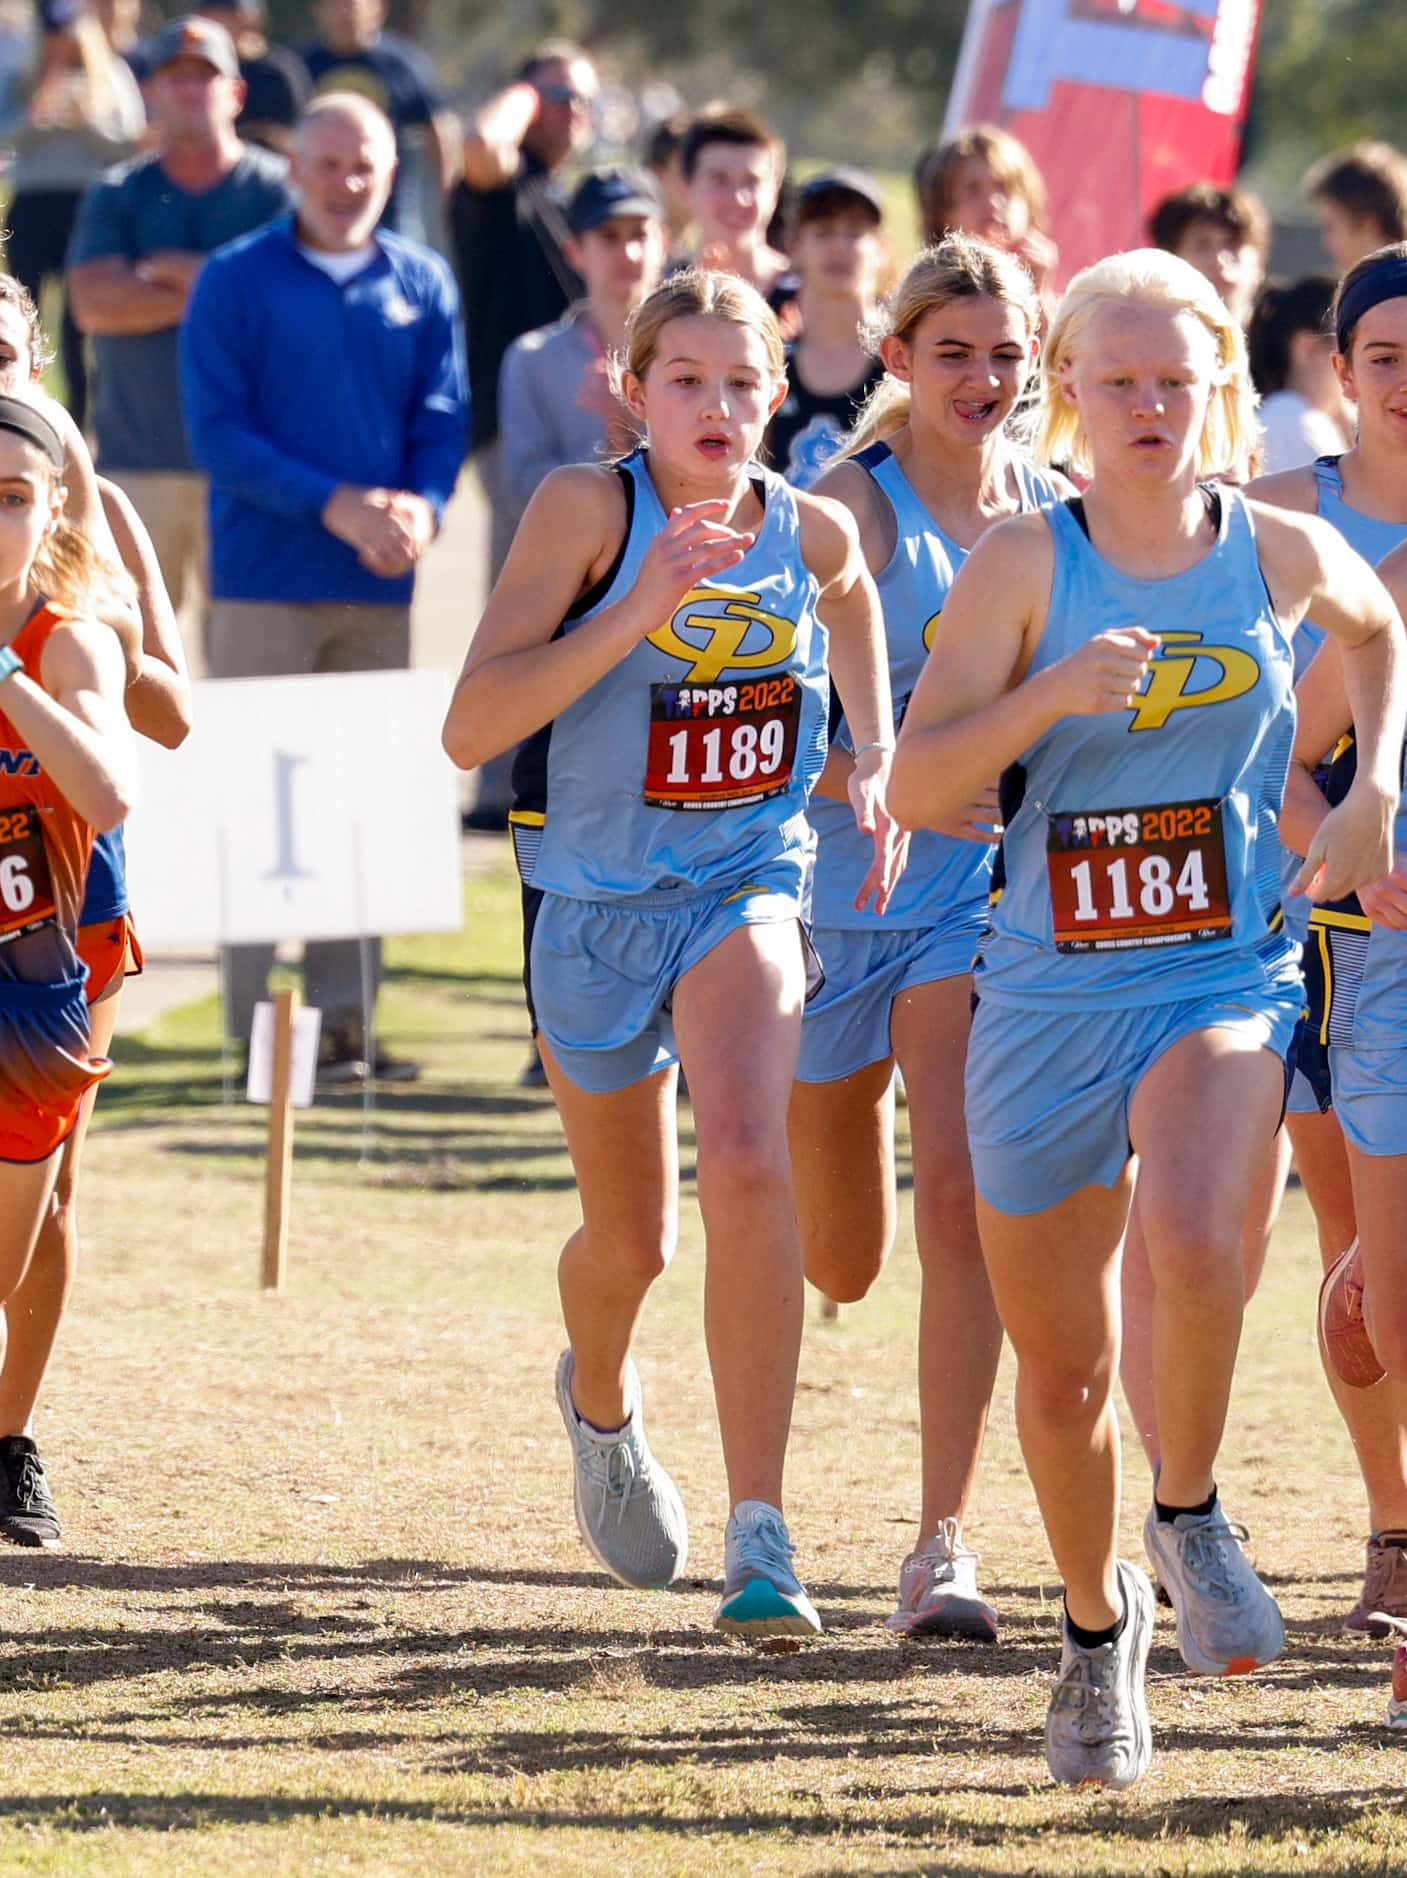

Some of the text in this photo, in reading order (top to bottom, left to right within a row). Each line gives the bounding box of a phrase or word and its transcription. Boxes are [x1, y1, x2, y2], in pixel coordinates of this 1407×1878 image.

[661, 678, 795, 718] TAPPS 2022
[666, 719, 785, 783] 1189
[1056, 807, 1212, 846] TAPPS 2022
[1070, 849, 1209, 921] 1184
